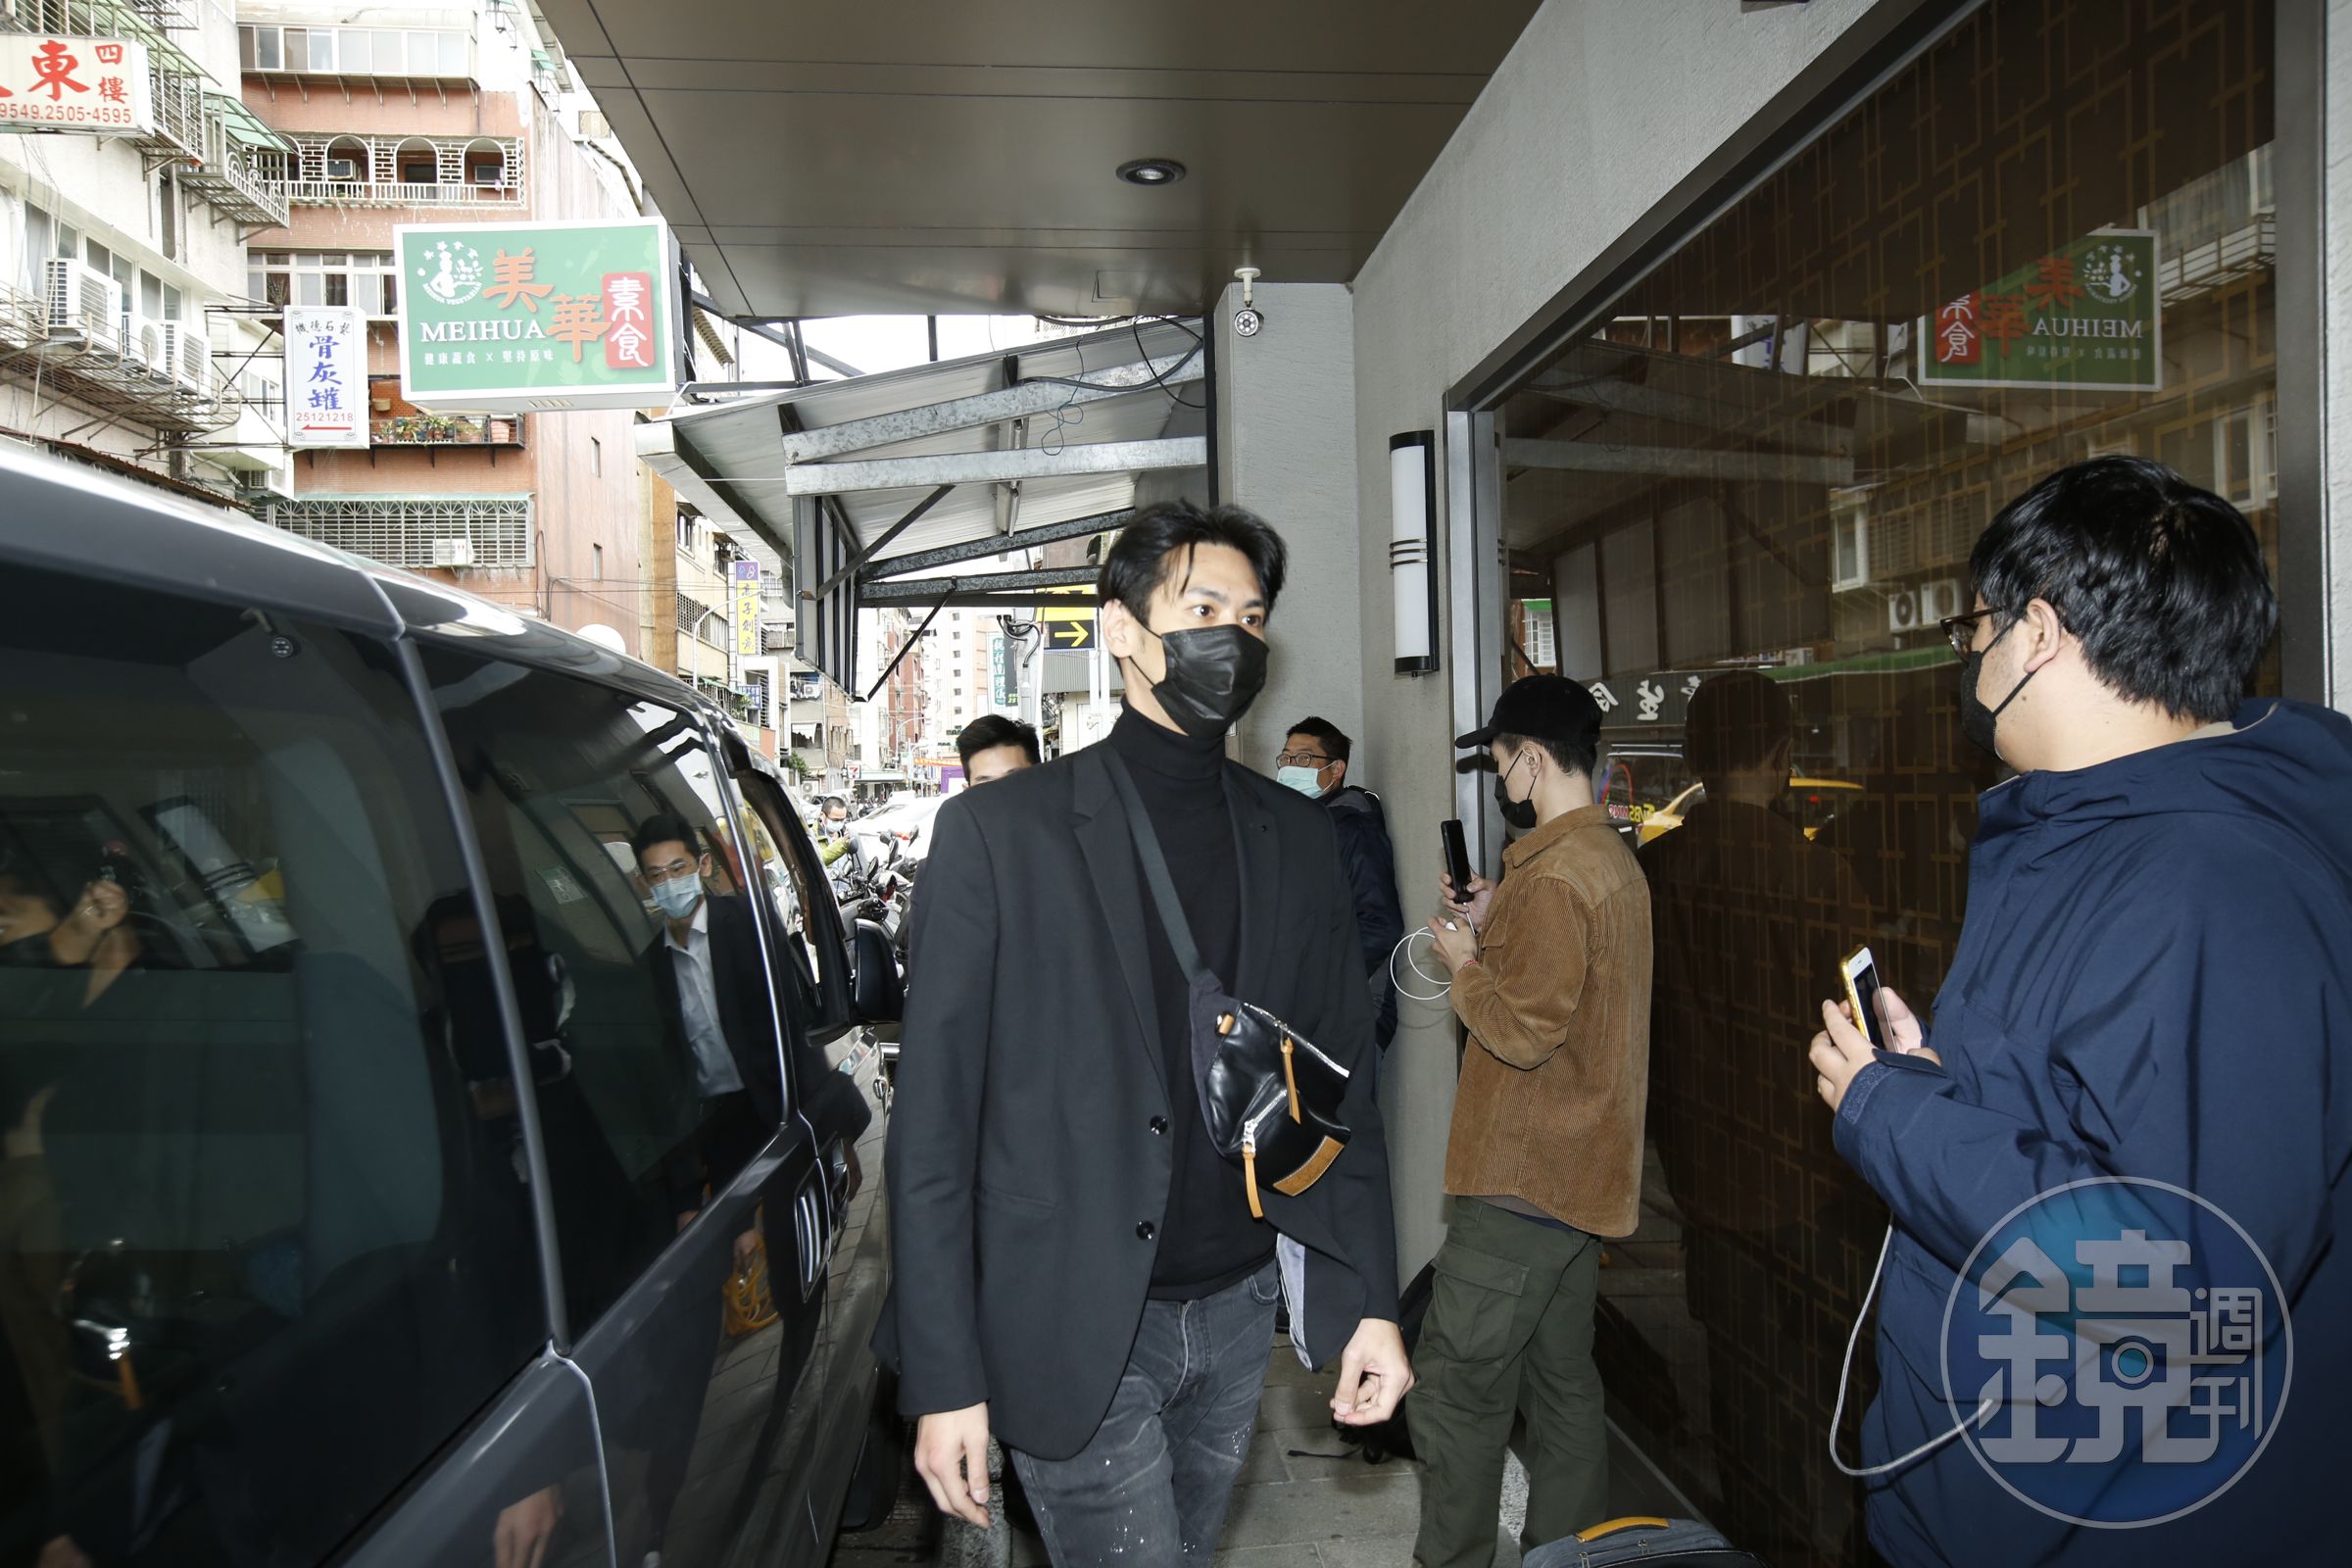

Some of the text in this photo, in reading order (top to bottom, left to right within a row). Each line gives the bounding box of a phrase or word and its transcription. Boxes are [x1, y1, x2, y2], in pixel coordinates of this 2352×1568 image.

[0, 39, 90, 102] 東
[94, 43, 129, 105] 四樓
[419, 318, 547, 343] MEIHUA
[483, 247, 612, 363] 美華
[607, 276, 649, 368] 素食
[307, 334, 343, 411] 骨灰罐
[296, 412, 354, 422] 25121218
